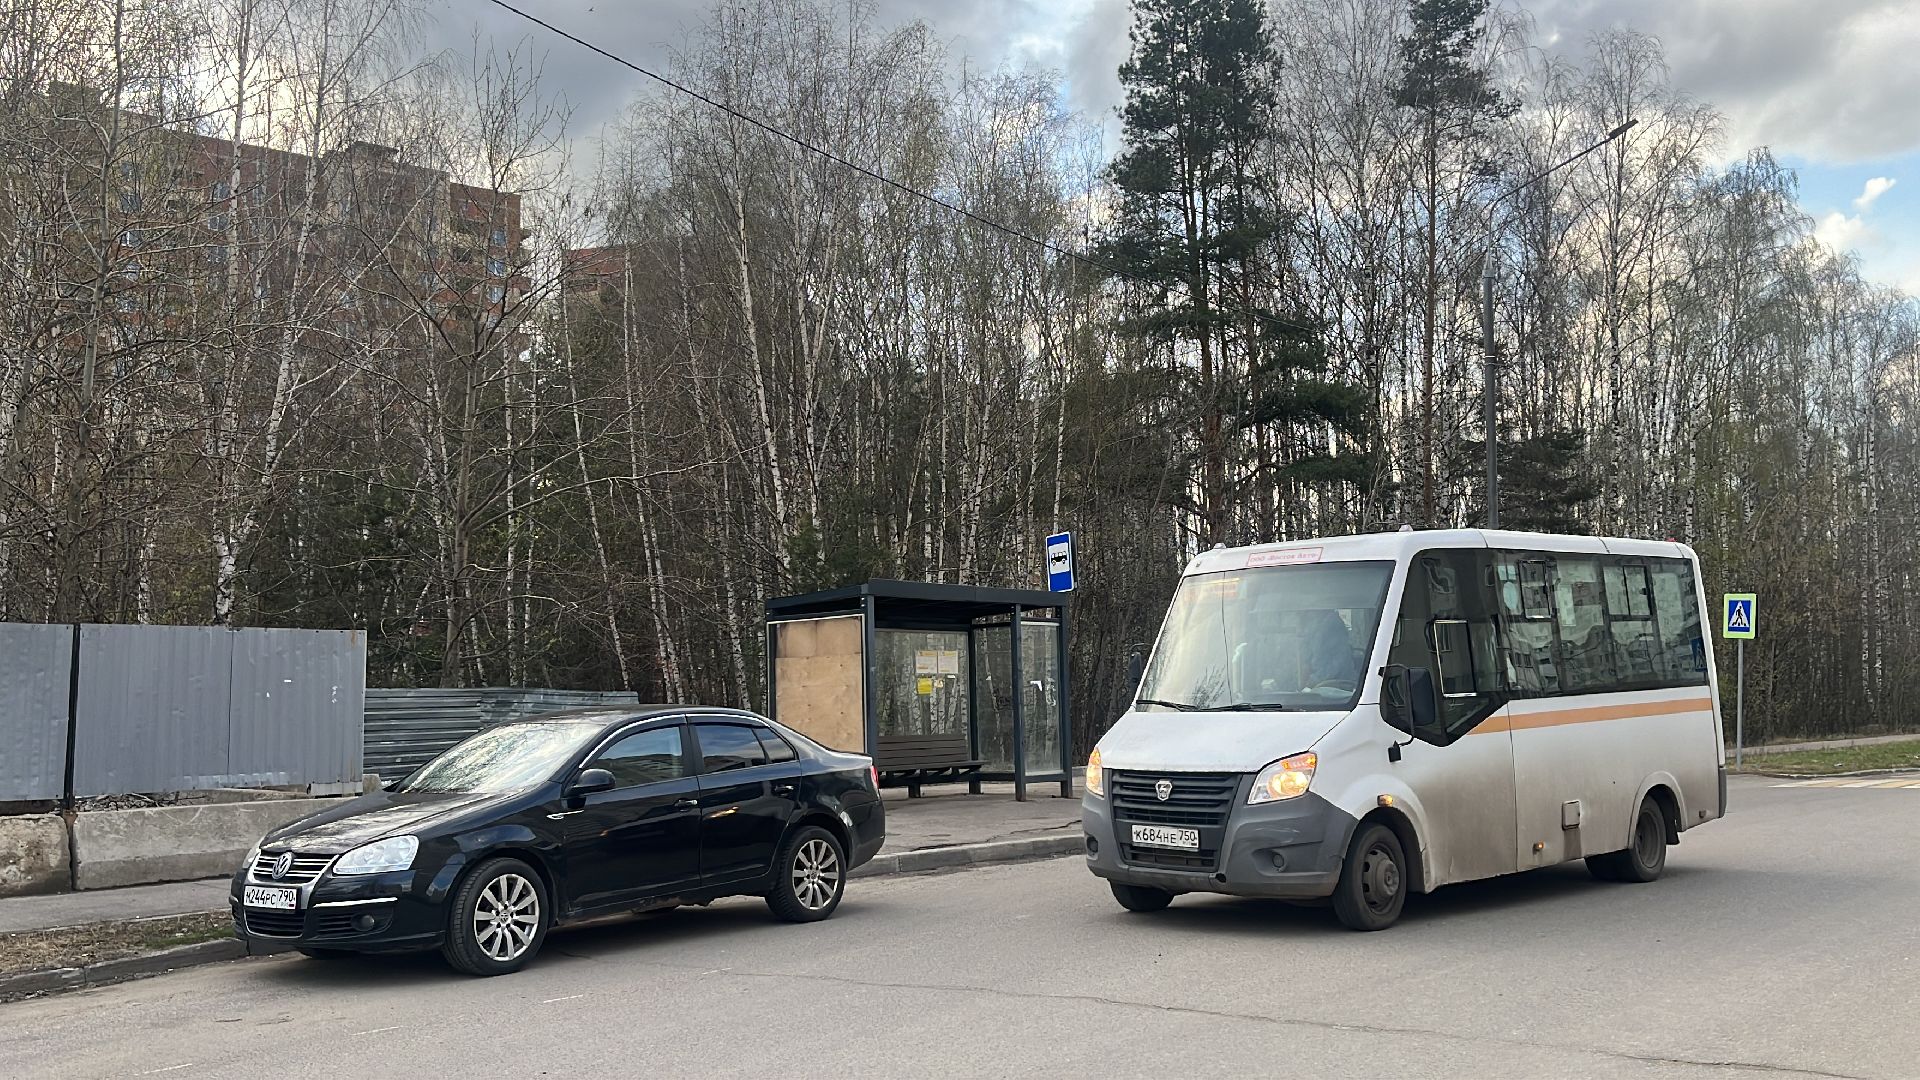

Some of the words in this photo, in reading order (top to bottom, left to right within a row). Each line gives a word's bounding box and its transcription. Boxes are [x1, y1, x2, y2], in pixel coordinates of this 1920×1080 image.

[1135, 828, 1177, 843] К684НЕ
[1179, 829, 1196, 842] 750
[246, 888, 277, 905] М244РС
[278, 889, 294, 902] 790
